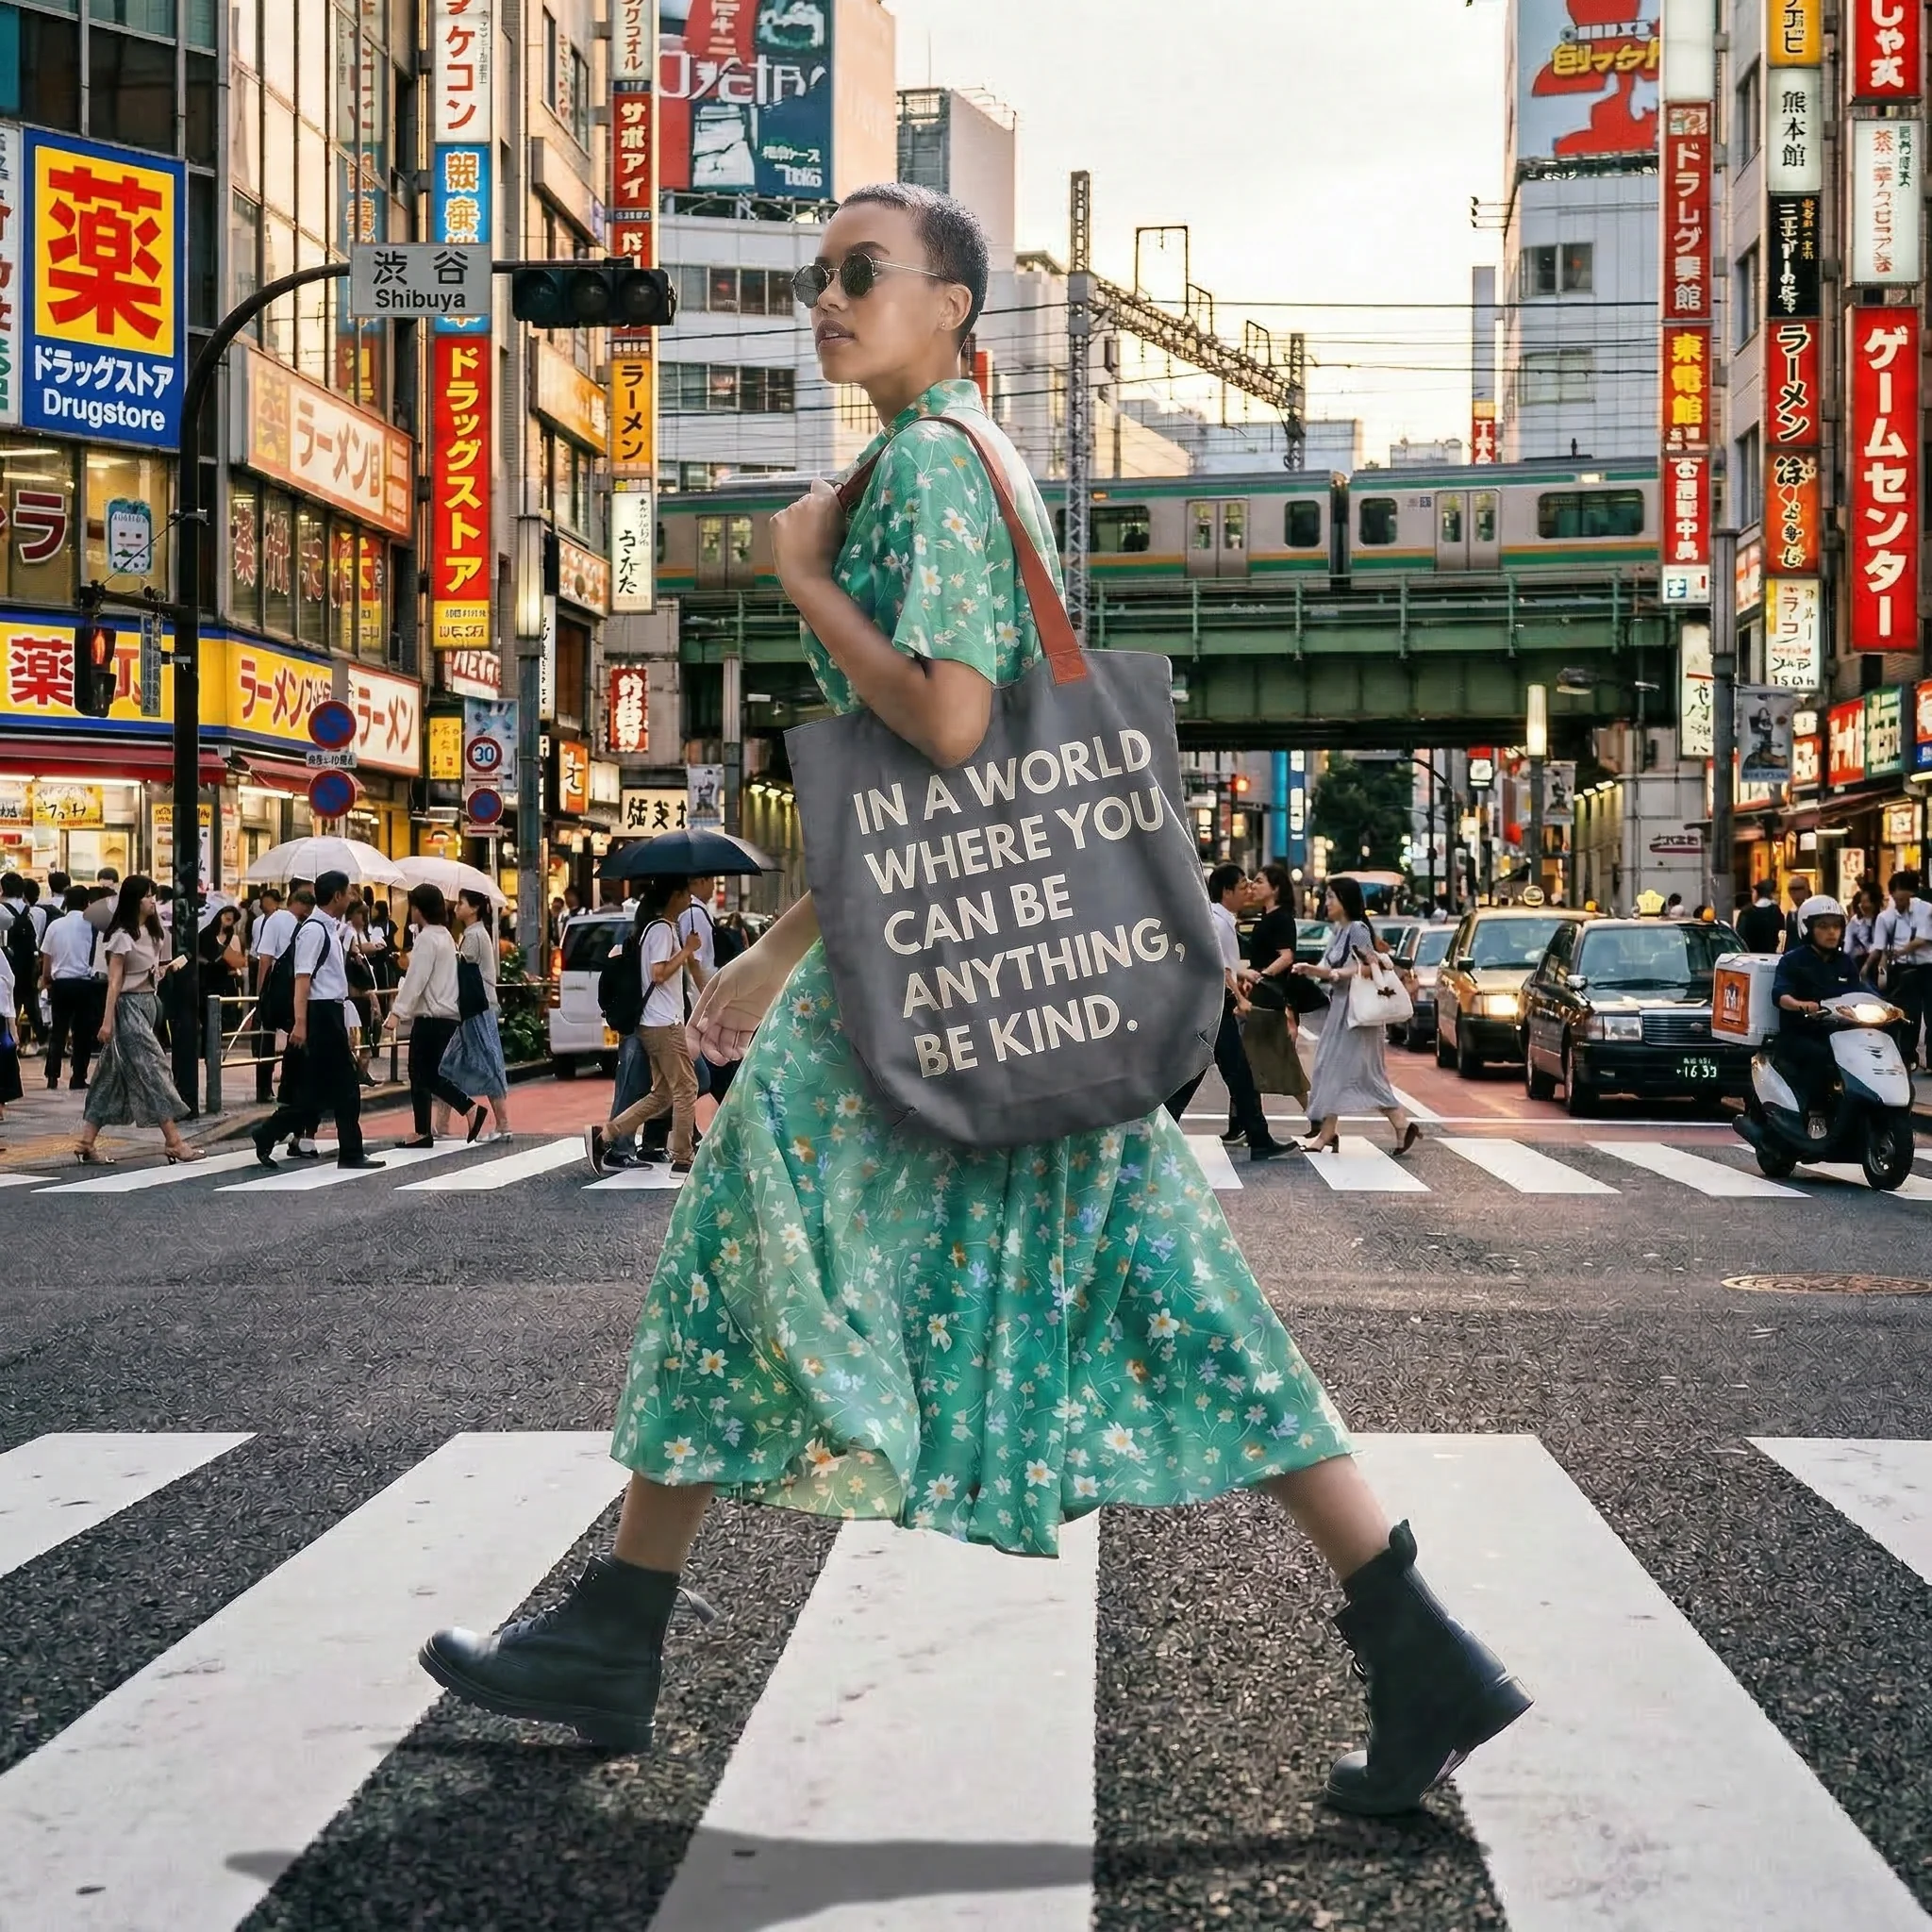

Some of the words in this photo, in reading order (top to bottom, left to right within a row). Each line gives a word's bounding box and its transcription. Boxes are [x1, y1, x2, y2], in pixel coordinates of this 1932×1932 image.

[1781, 91, 1807, 167] 熊本館
[47, 165, 163, 341] 薬
[373, 250, 469, 286] 渋谷
[375, 289, 466, 313] Shibuya
[34, 344, 175, 399] ドラッグストア
[43, 389, 165, 431] Drugstore
[622, 364, 644, 460] ラーメン
[1776, 324, 1810, 442] ラーメン
[444, 347, 484, 592] ドラッグストア
[1863, 325, 1909, 637] ゲームセンター
[10, 638, 74, 707] 薬
[358, 686, 413, 755] ラーメン
[475, 746, 494, 761] 30
[853, 783, 908, 836] IN
[924, 774, 962, 821] A
[963, 728, 1152, 808] WORLD
[863, 815, 1053, 894] WHERE
[1055, 786, 1165, 850] YOU
[883, 891, 998, 955] CAN
[1010, 874, 1074, 928] BE
[903, 917, 1186, 1019] ANYTHING,
[913, 1025, 979, 1077] BE
[989, 994, 1139, 1062] KIND.
